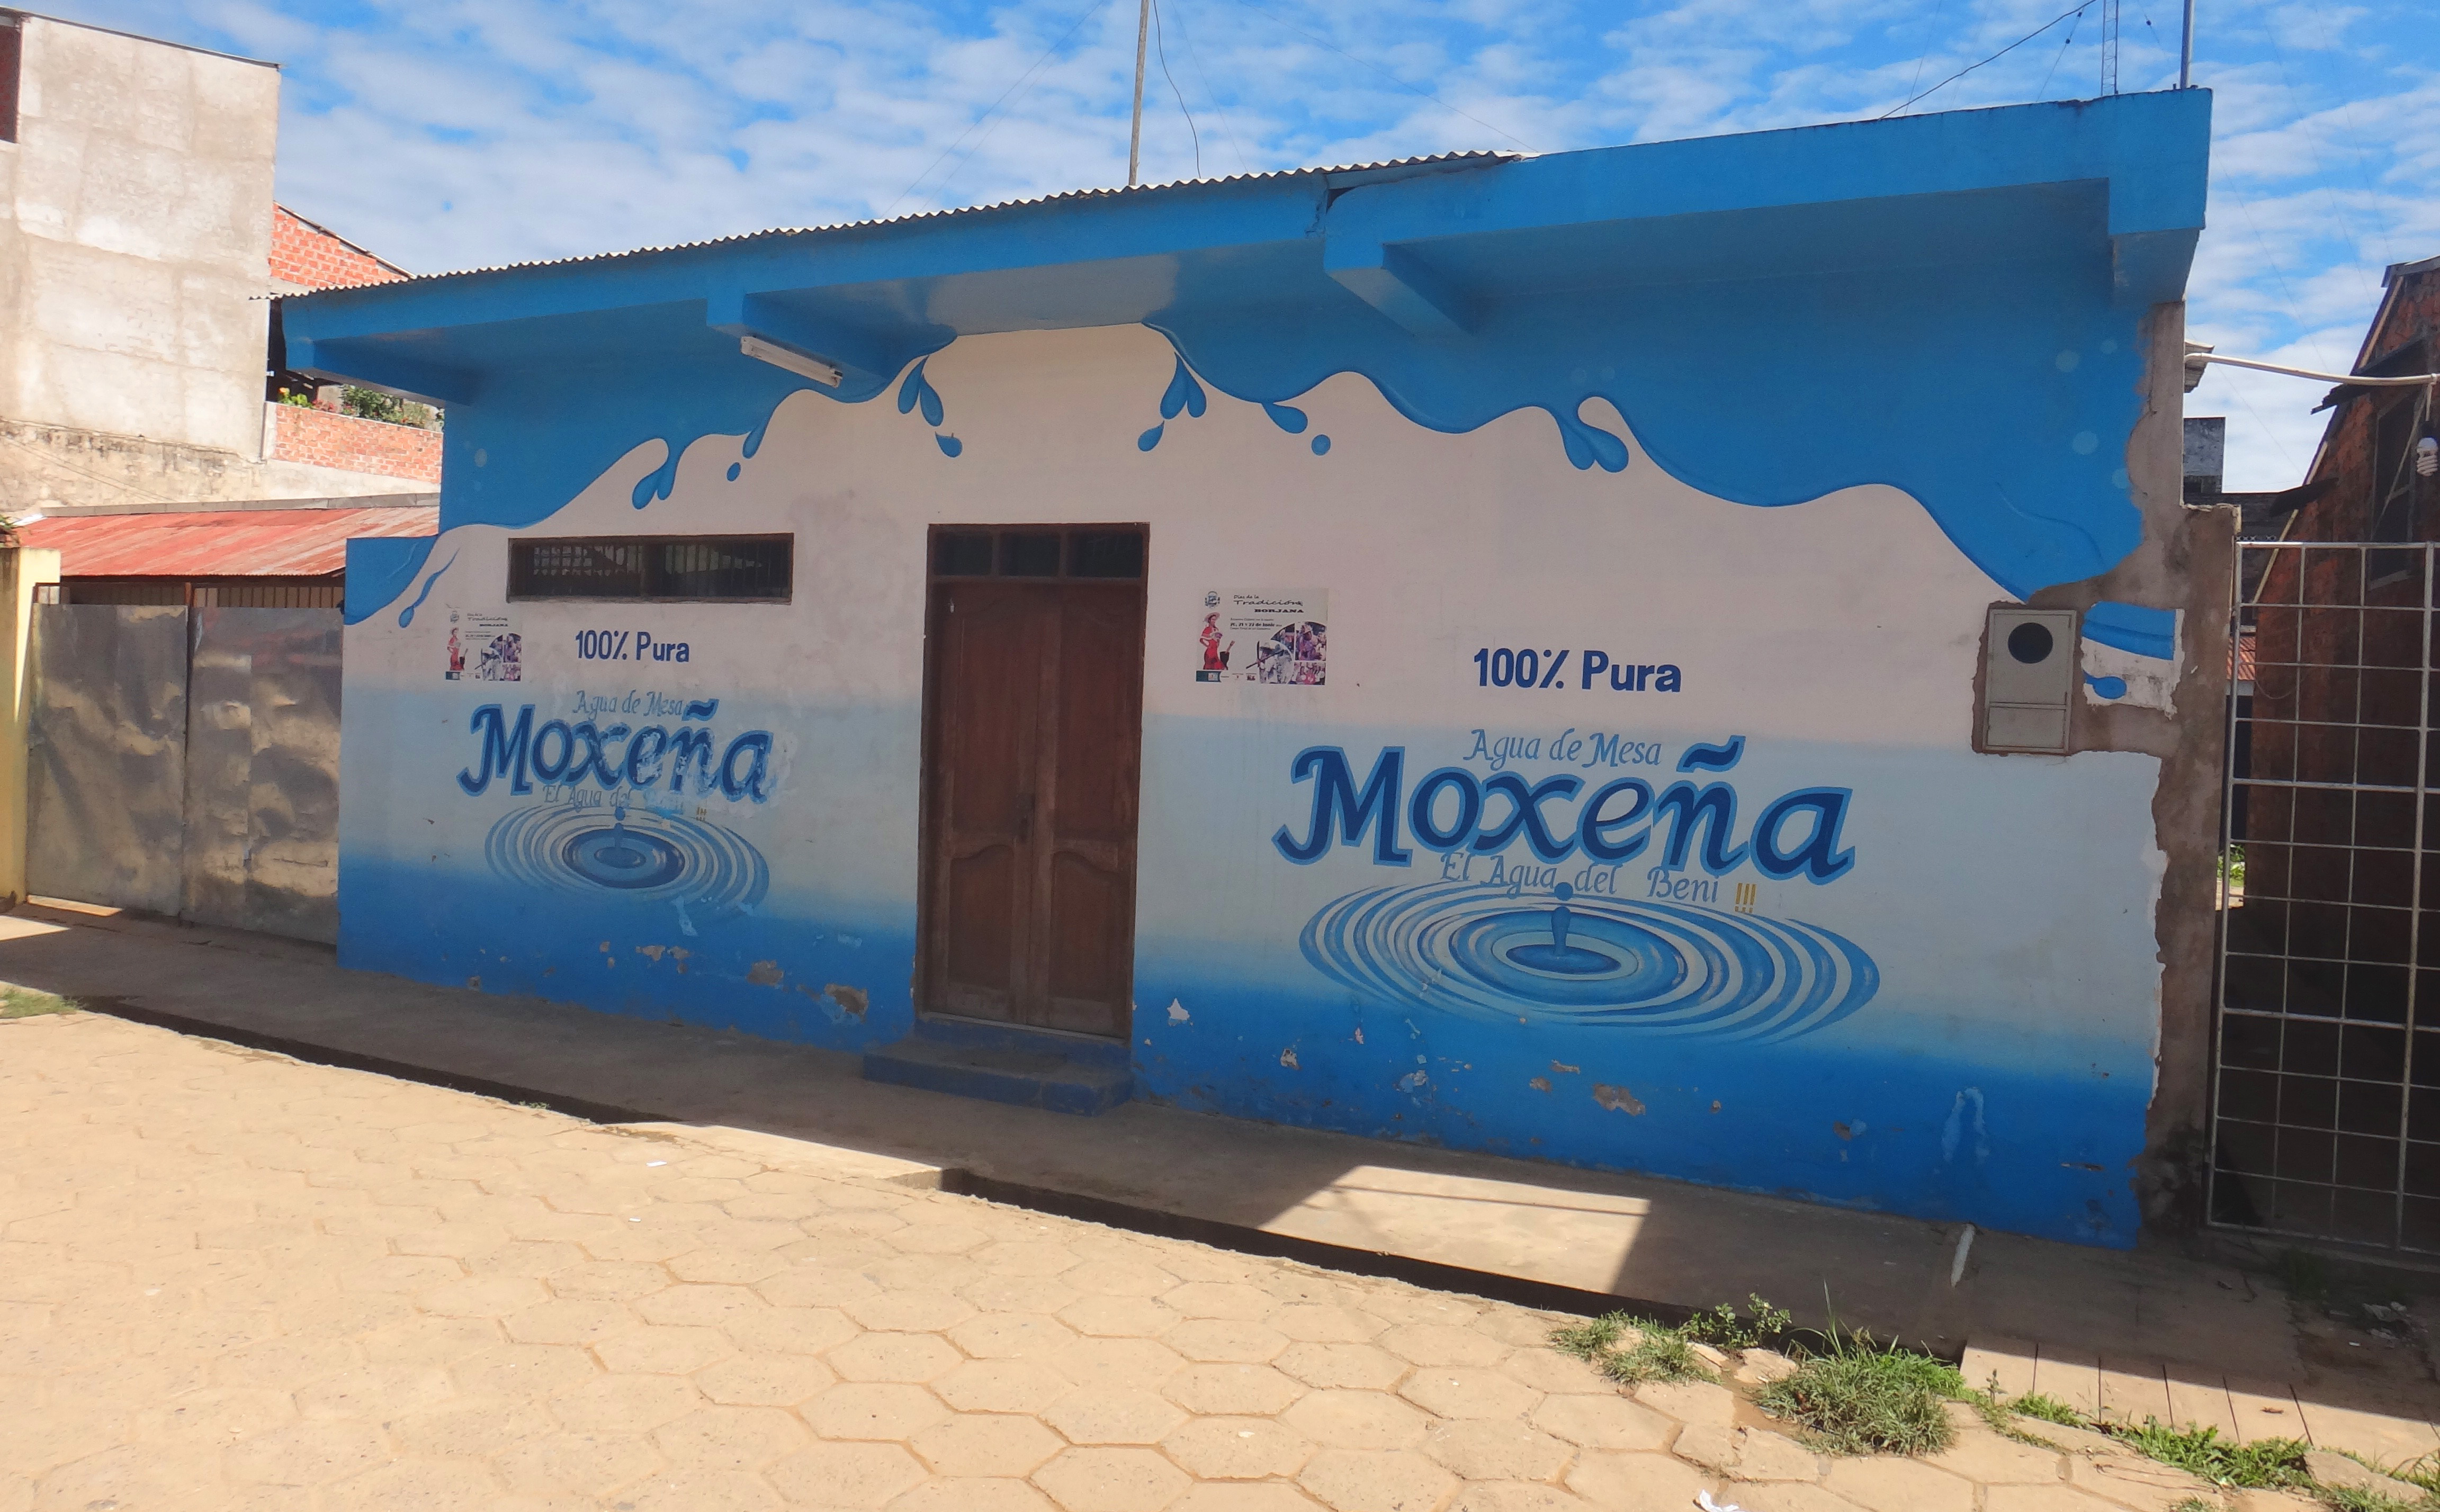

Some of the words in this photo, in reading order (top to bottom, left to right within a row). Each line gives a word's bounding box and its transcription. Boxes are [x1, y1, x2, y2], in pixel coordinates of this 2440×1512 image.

[575, 630, 630, 660] 100%
[636, 631, 689, 662] Pura
[1474, 648, 1570, 689] 100%
[1582, 650, 1682, 692] Pura
[572, 690, 618, 721] Agua
[621, 689, 641, 714] de
[643, 691, 684, 716] Mesa
[456, 698, 774, 805] Moxeña
[1463, 728, 1541, 771] Agua
[1549, 727, 1583, 761] de
[1582, 732, 1662, 768] Mesa
[542, 784, 562, 803] El
[568, 785, 603, 812] Agua
[609, 786, 631, 807] del
[1271, 735, 1856, 886] Moxeña
[1440, 851, 1472, 882] El
[1481, 855, 1557, 899] Agua
[1574, 862, 1623, 895] del
[1647, 866, 1720, 903] Beni
